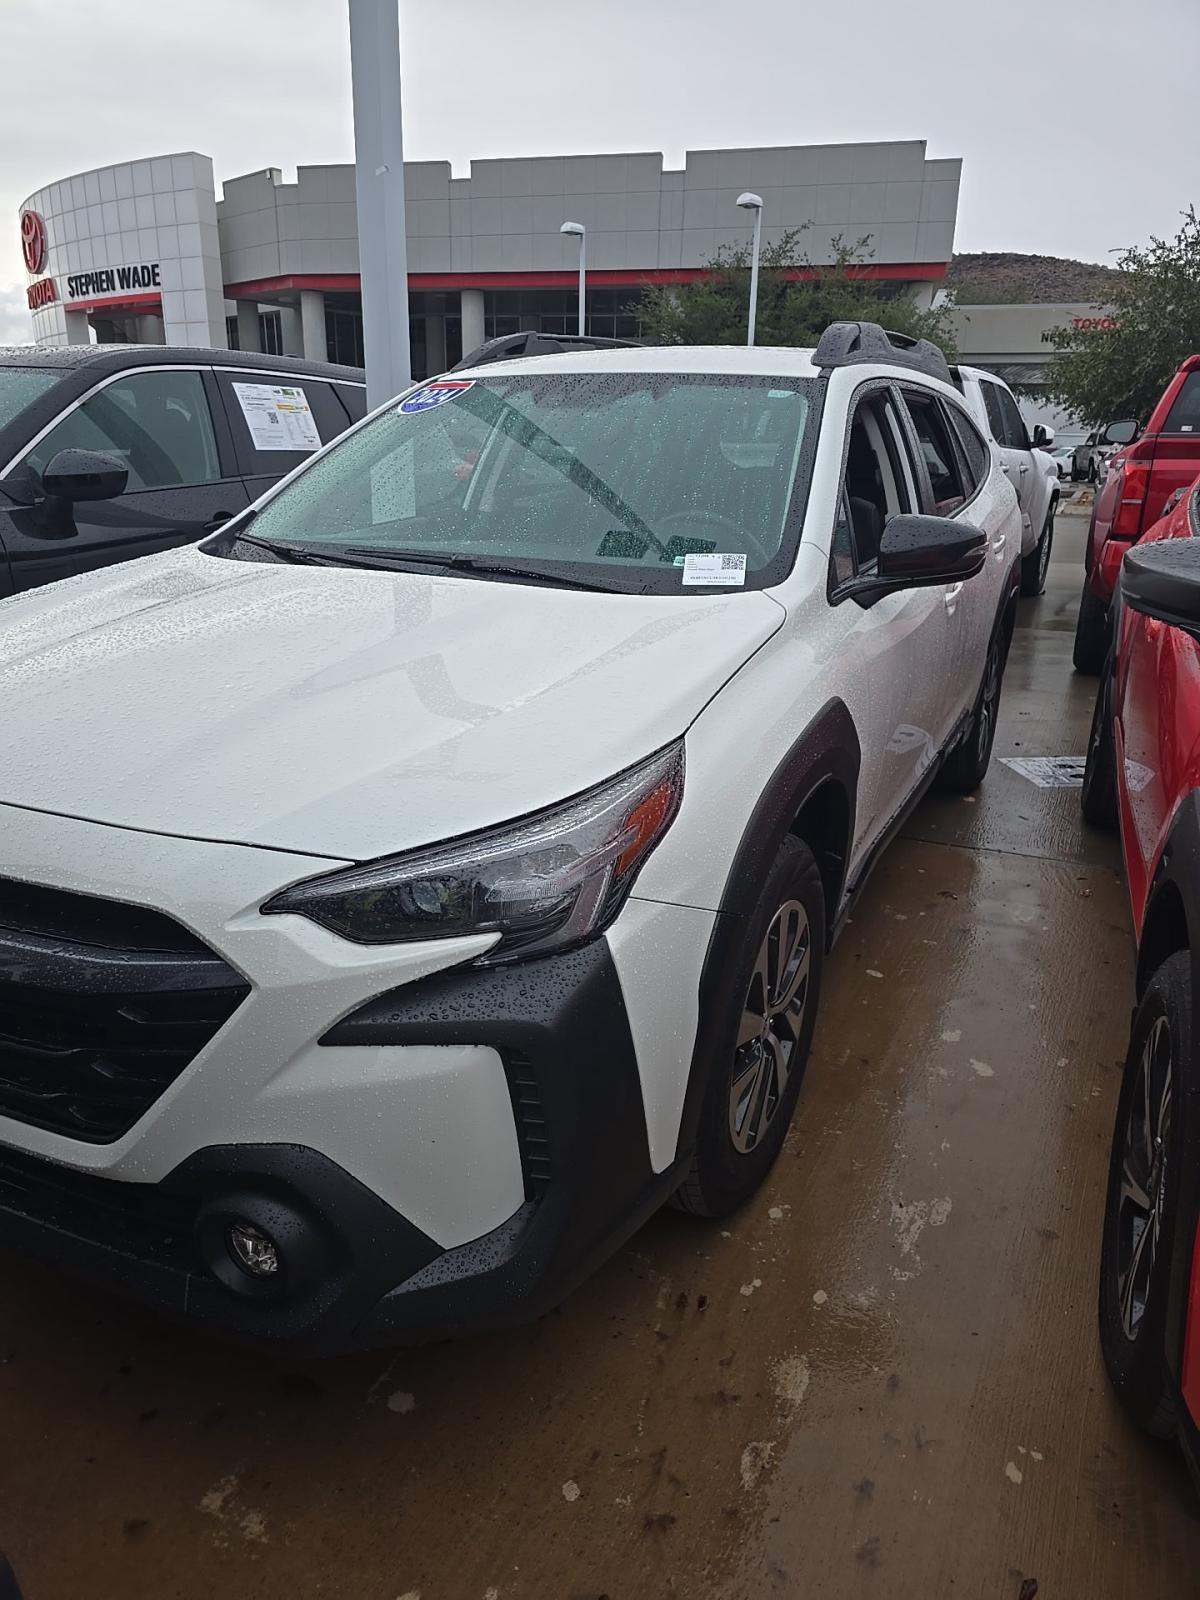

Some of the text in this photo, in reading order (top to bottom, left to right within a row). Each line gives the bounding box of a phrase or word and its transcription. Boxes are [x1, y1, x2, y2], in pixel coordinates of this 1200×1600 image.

[68, 264, 161, 298] STEPHEN WADE
[1072, 318, 1119, 330] TOYO
